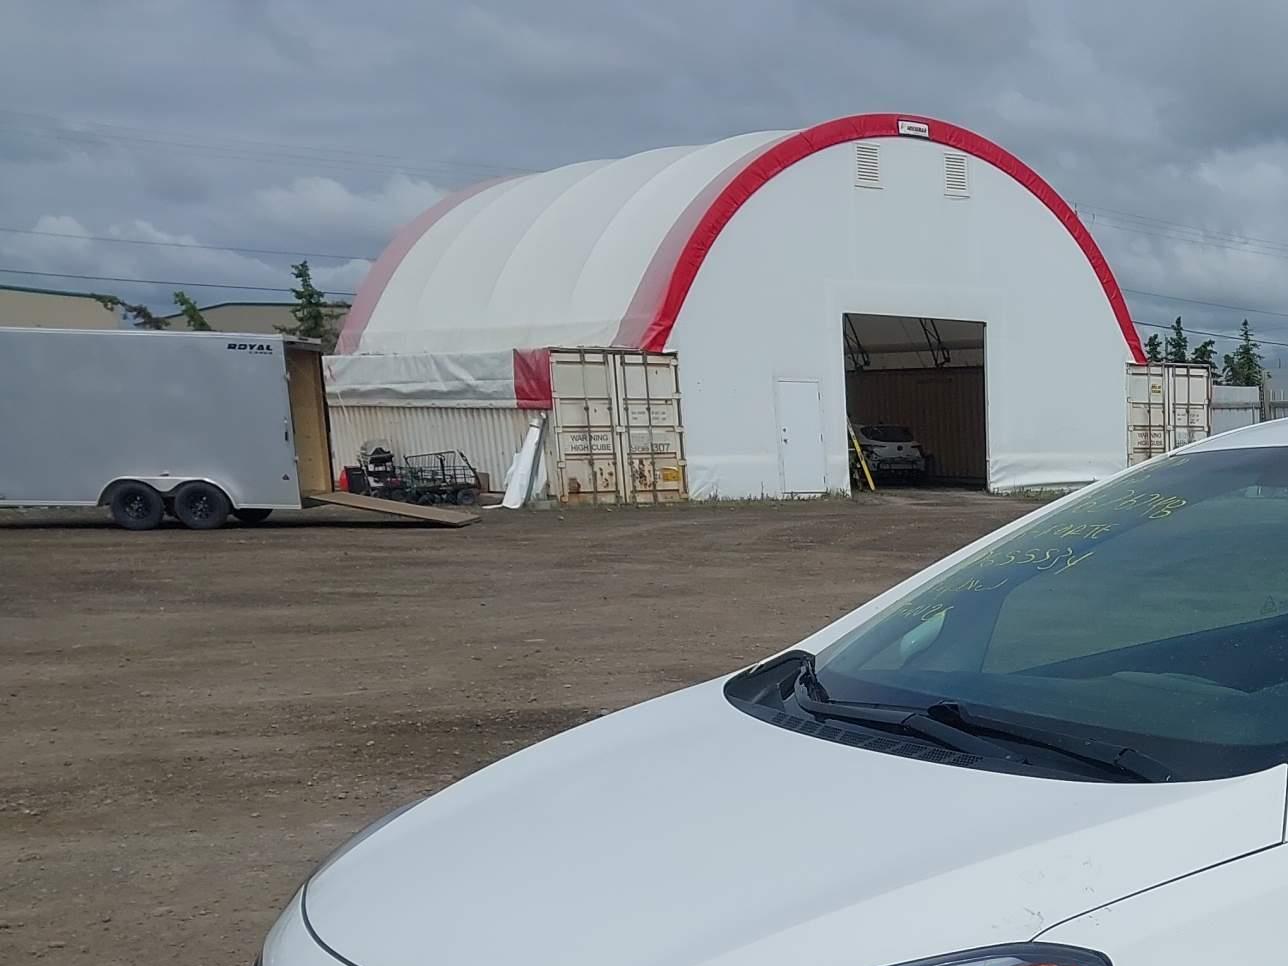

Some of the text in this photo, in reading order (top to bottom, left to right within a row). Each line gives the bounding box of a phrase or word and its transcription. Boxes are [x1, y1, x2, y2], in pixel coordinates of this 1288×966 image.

[226, 343, 273, 351] ROYAL
[570, 434, 609, 442] WARNING
[570, 443, 612, 452] HIGH CUBE
